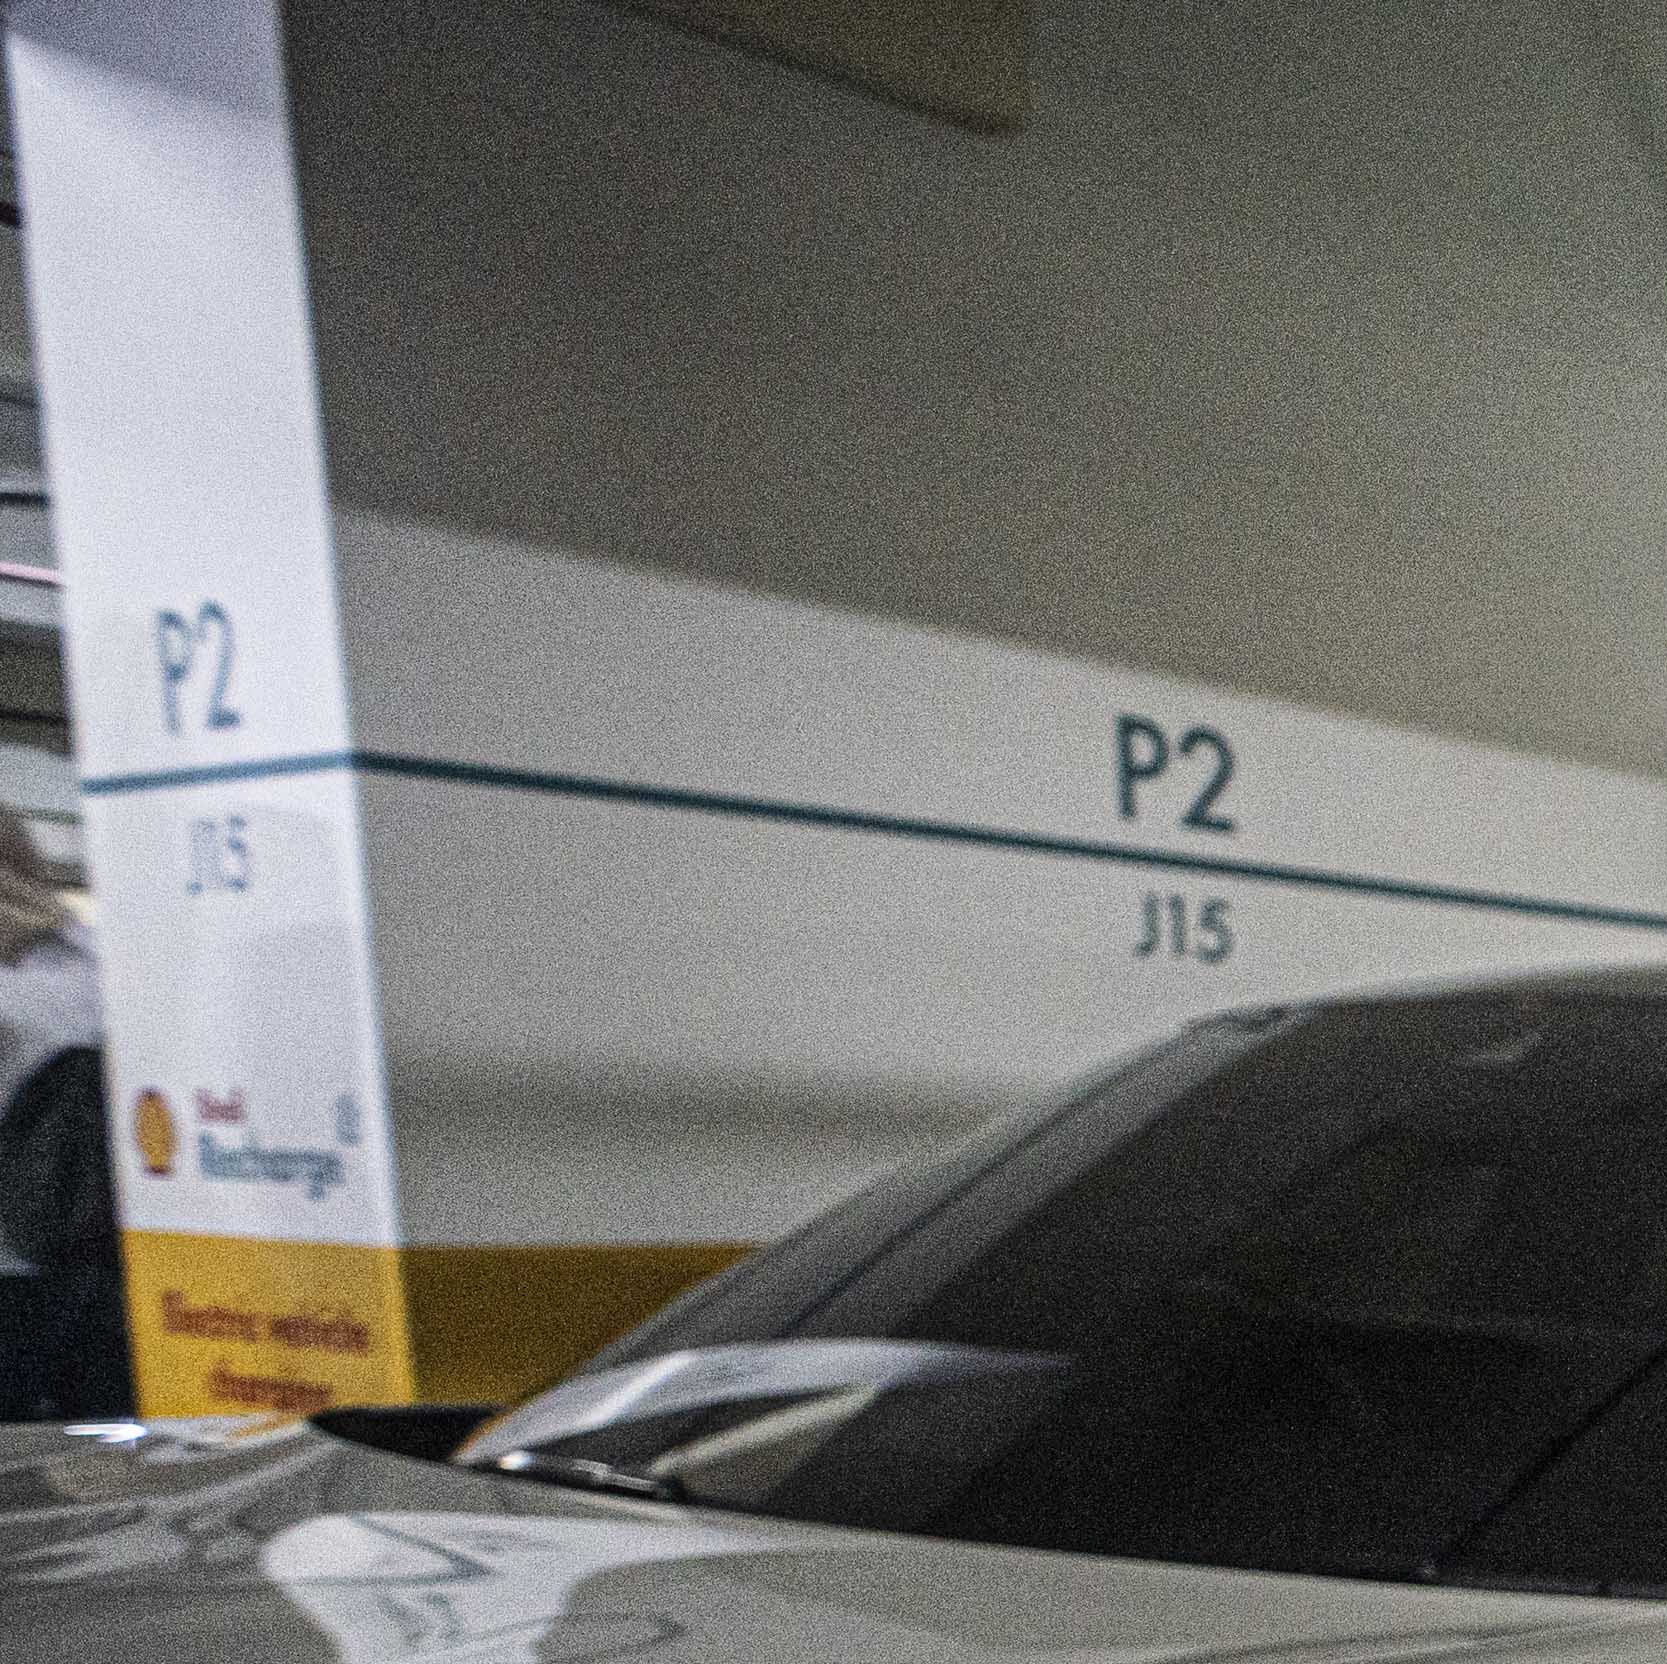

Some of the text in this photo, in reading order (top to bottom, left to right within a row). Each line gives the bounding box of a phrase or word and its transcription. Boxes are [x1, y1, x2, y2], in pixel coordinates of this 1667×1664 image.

[156, 598, 242, 738] P2
[1115, 713, 1234, 832] P2
[186, 815, 249, 895] J15
[1133, 891, 1233, 963] J15
